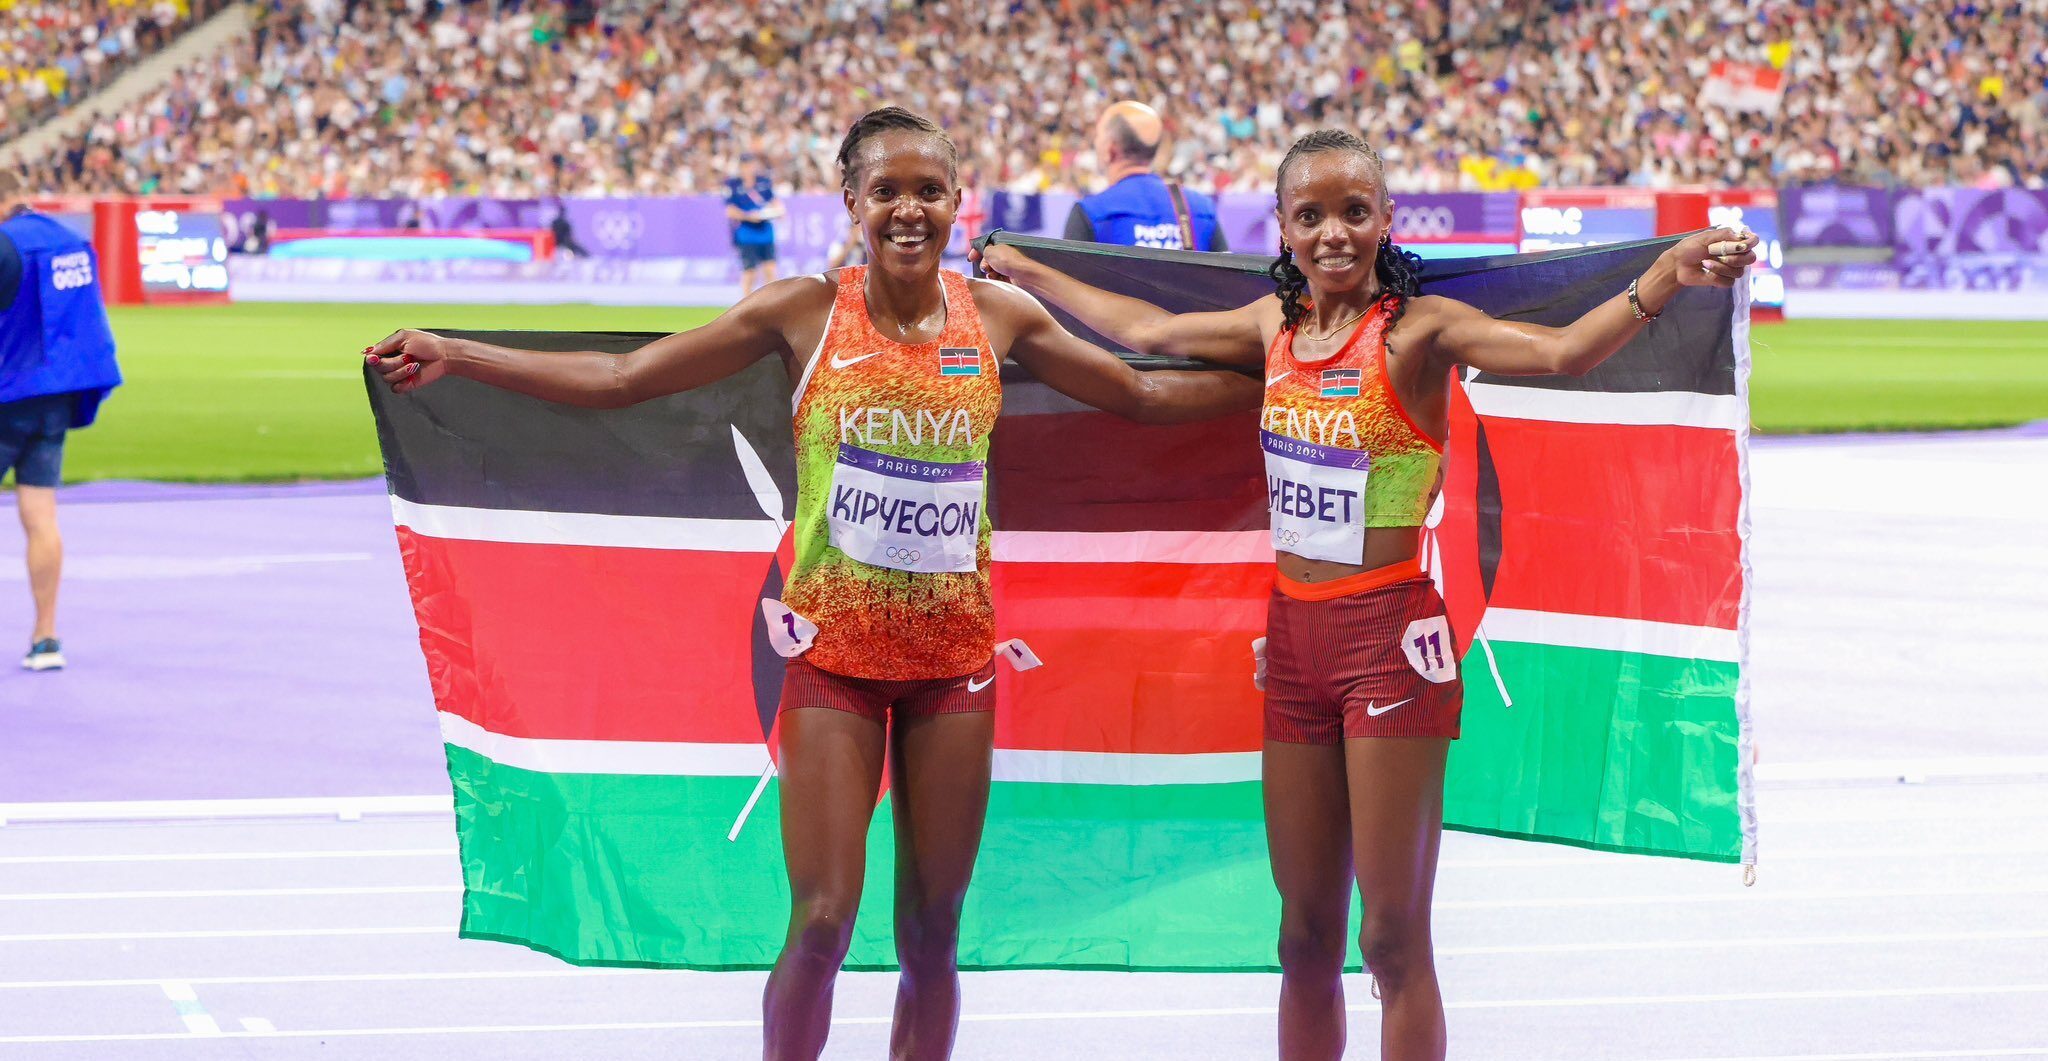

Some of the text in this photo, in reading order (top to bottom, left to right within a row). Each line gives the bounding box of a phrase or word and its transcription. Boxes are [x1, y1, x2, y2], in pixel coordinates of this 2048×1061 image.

[839, 405, 973, 446] KENYA
[876, 458, 953, 477] PARIS 2024
[1268, 437, 1325, 460] PARIS 2024
[832, 484, 978, 537] KIPYEGON
[1269, 474, 1358, 524] HEBET
[1413, 630, 1444, 671] 11
